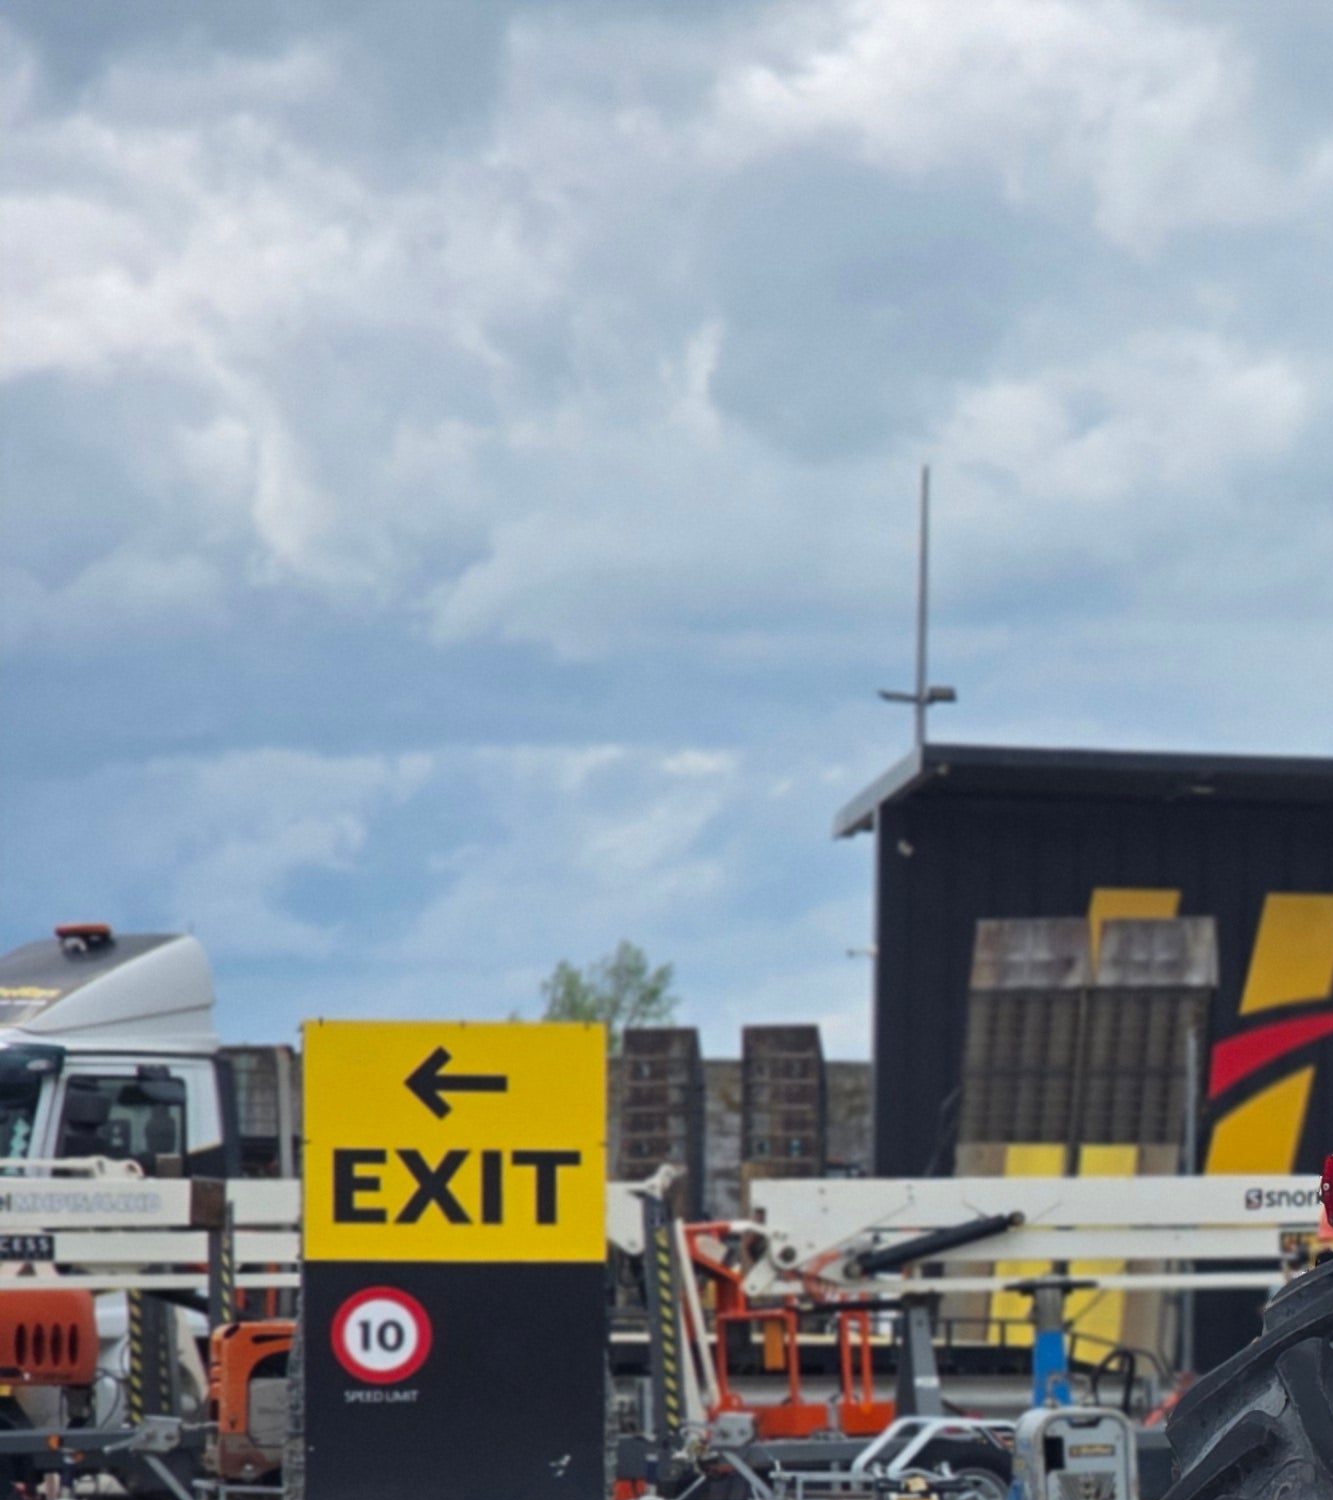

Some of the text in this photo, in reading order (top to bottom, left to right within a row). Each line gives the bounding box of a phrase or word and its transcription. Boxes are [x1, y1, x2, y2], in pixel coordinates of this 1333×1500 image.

[332, 1147, 582, 1225] EXIT
[358, 1318, 406, 1353] 10
[344, 1389, 419, 1403] SPEED LIMIT
